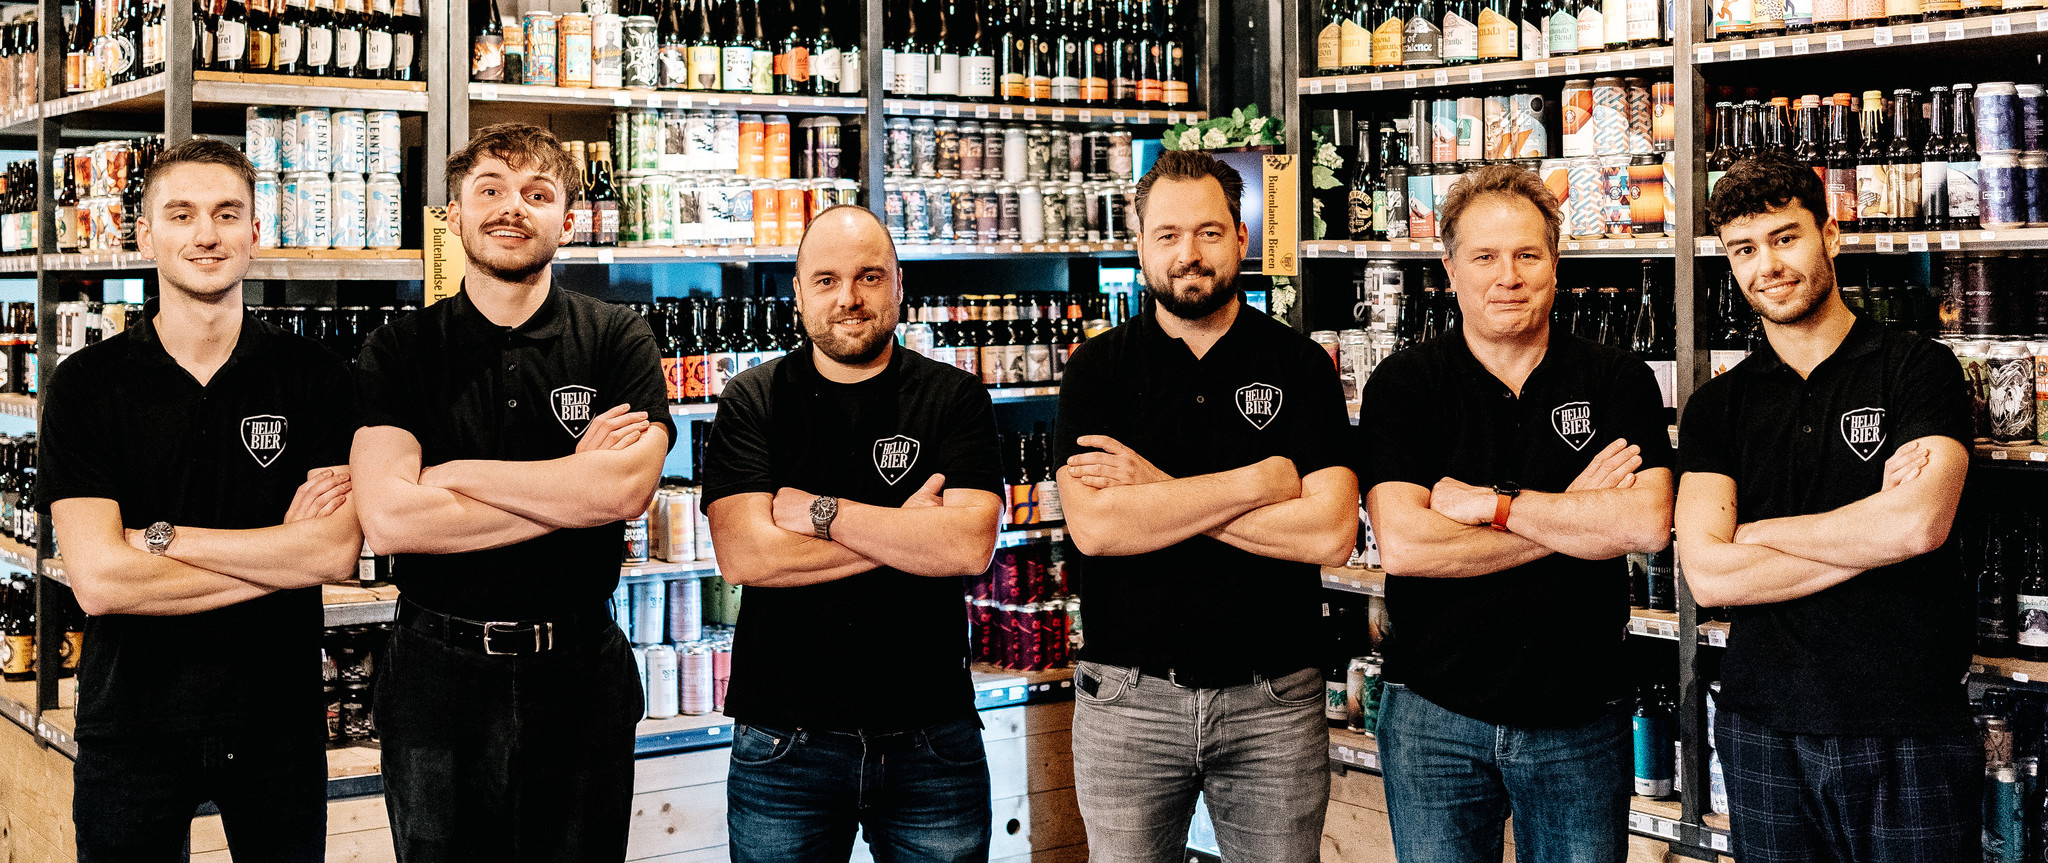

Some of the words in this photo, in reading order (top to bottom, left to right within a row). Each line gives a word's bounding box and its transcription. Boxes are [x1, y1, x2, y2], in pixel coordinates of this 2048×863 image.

[317, 118, 328, 162] TENNIS
[356, 119, 365, 164] TENNIS
[369, 119, 380, 164] TENNIS
[756, 131, 763, 142] H
[778, 132, 785, 143] H
[766, 198, 773, 208] H
[790, 198, 798, 208] H
[1268, 175, 1279, 236] Buitenlandse
[315, 193, 326, 238] TENNIS
[389, 193, 399, 238] TENNIS
[433, 228, 447, 291] Buitenlandse
[1268, 238, 1279, 269] Bieren
[561, 391, 591, 406] HELLO
[1245, 388, 1273, 402] HELLO
[561, 404, 591, 421] BIER
[1245, 400, 1273, 416] BIER
[1561, 405, 1590, 422] HELLO
[251, 420, 282, 435] HELLO
[1562, 418, 1592, 435] BIER
[1850, 412, 1880, 429] HELLO
[250, 433, 281, 450] BIER
[1850, 426, 1880, 444] BIER
[882, 441, 910, 455] HELLO
[880, 453, 908, 469] BIER
